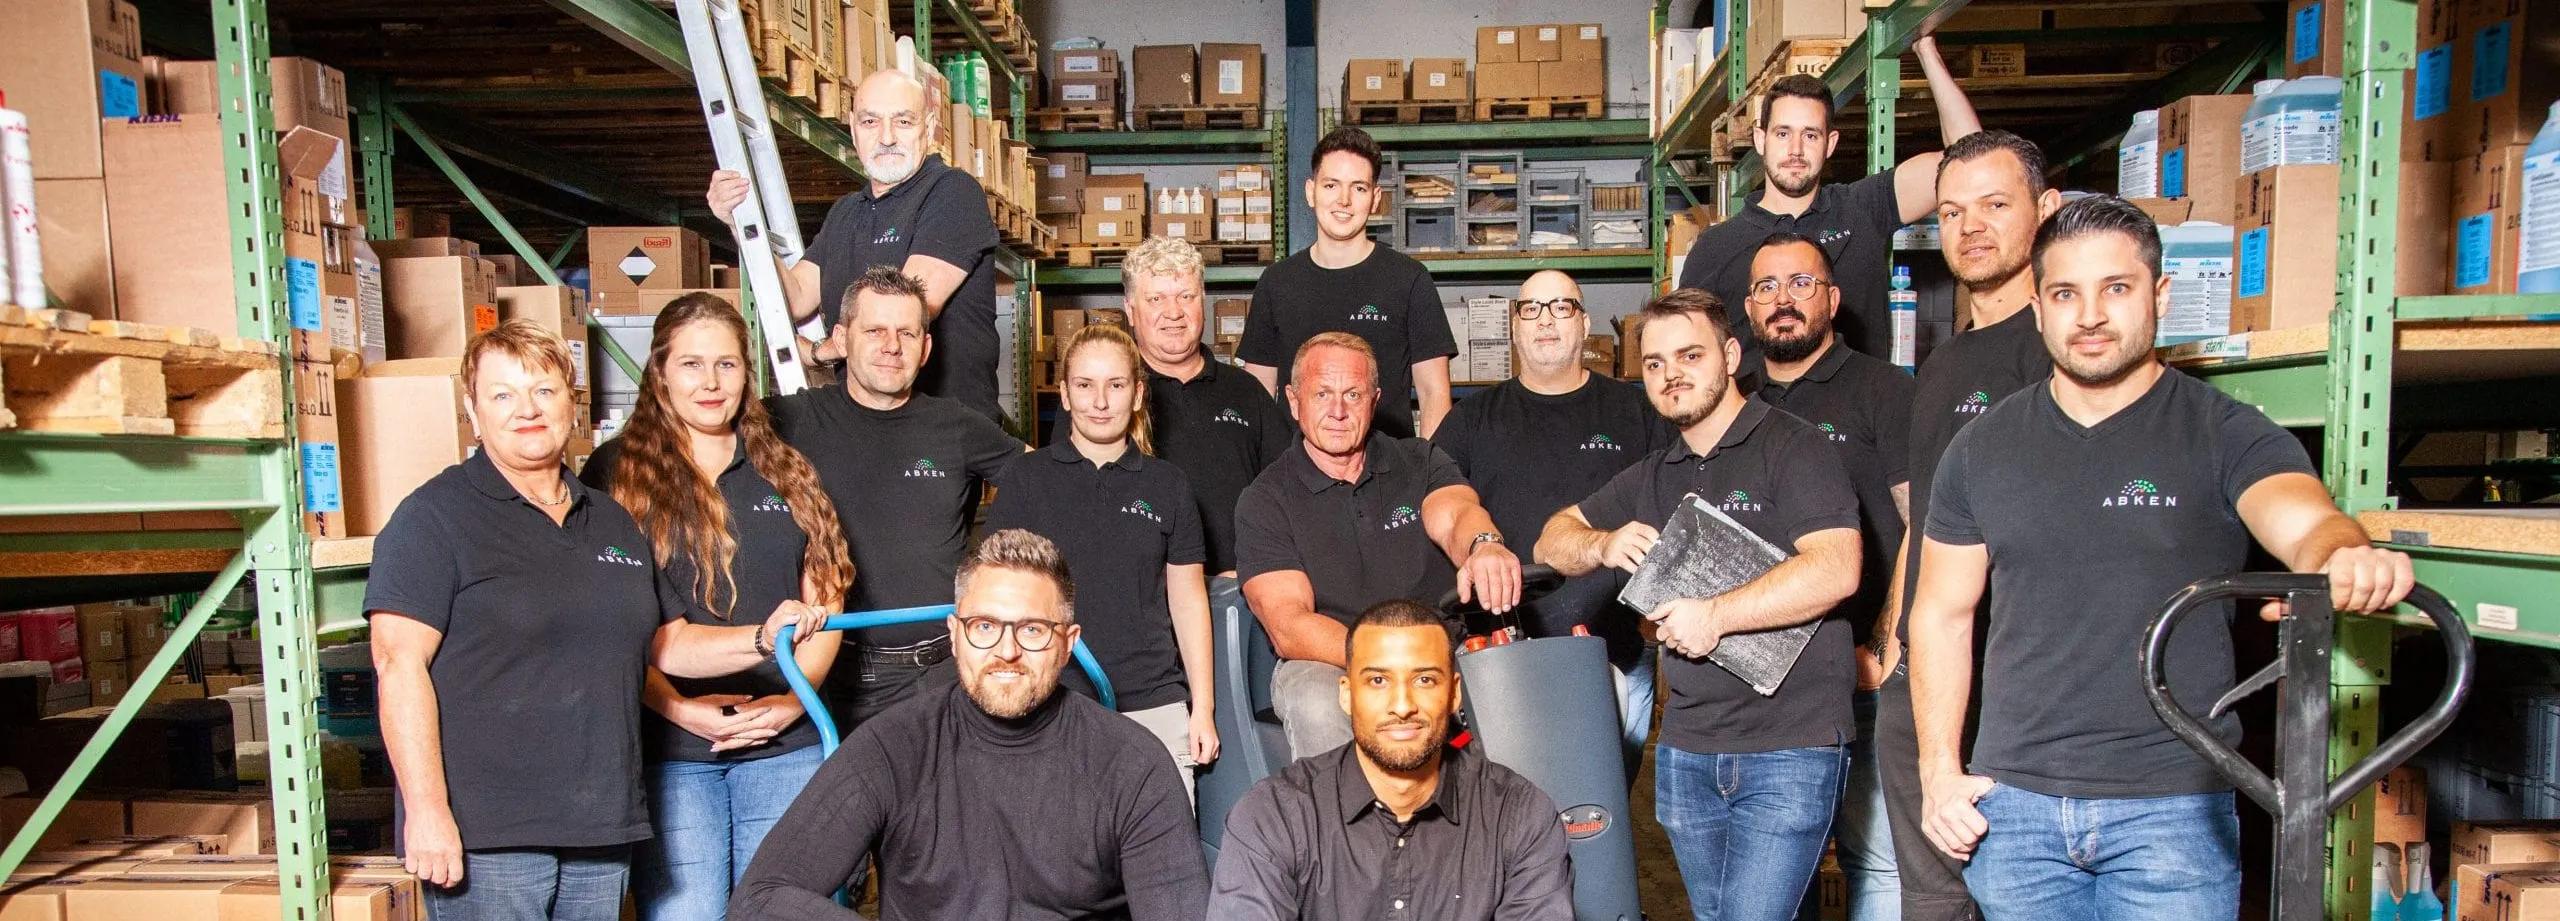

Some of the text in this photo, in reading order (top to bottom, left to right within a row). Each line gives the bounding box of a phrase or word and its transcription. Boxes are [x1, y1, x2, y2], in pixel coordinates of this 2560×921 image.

[1820, 229, 1851, 244] BKEN
[1349, 313, 1388, 321] ABKEN
[1954, 404, 1988, 414] ABKE
[1214, 415, 1250, 427] ABKEN
[1579, 442, 1622, 451] ABKEN
[904, 469, 946, 478] ABKEN
[2102, 495, 2177, 507] ABKEN
[753, 504, 790, 512] ABKE
[1121, 506, 1162, 523] ABKEN
[597, 554, 643, 567] ABKEN
